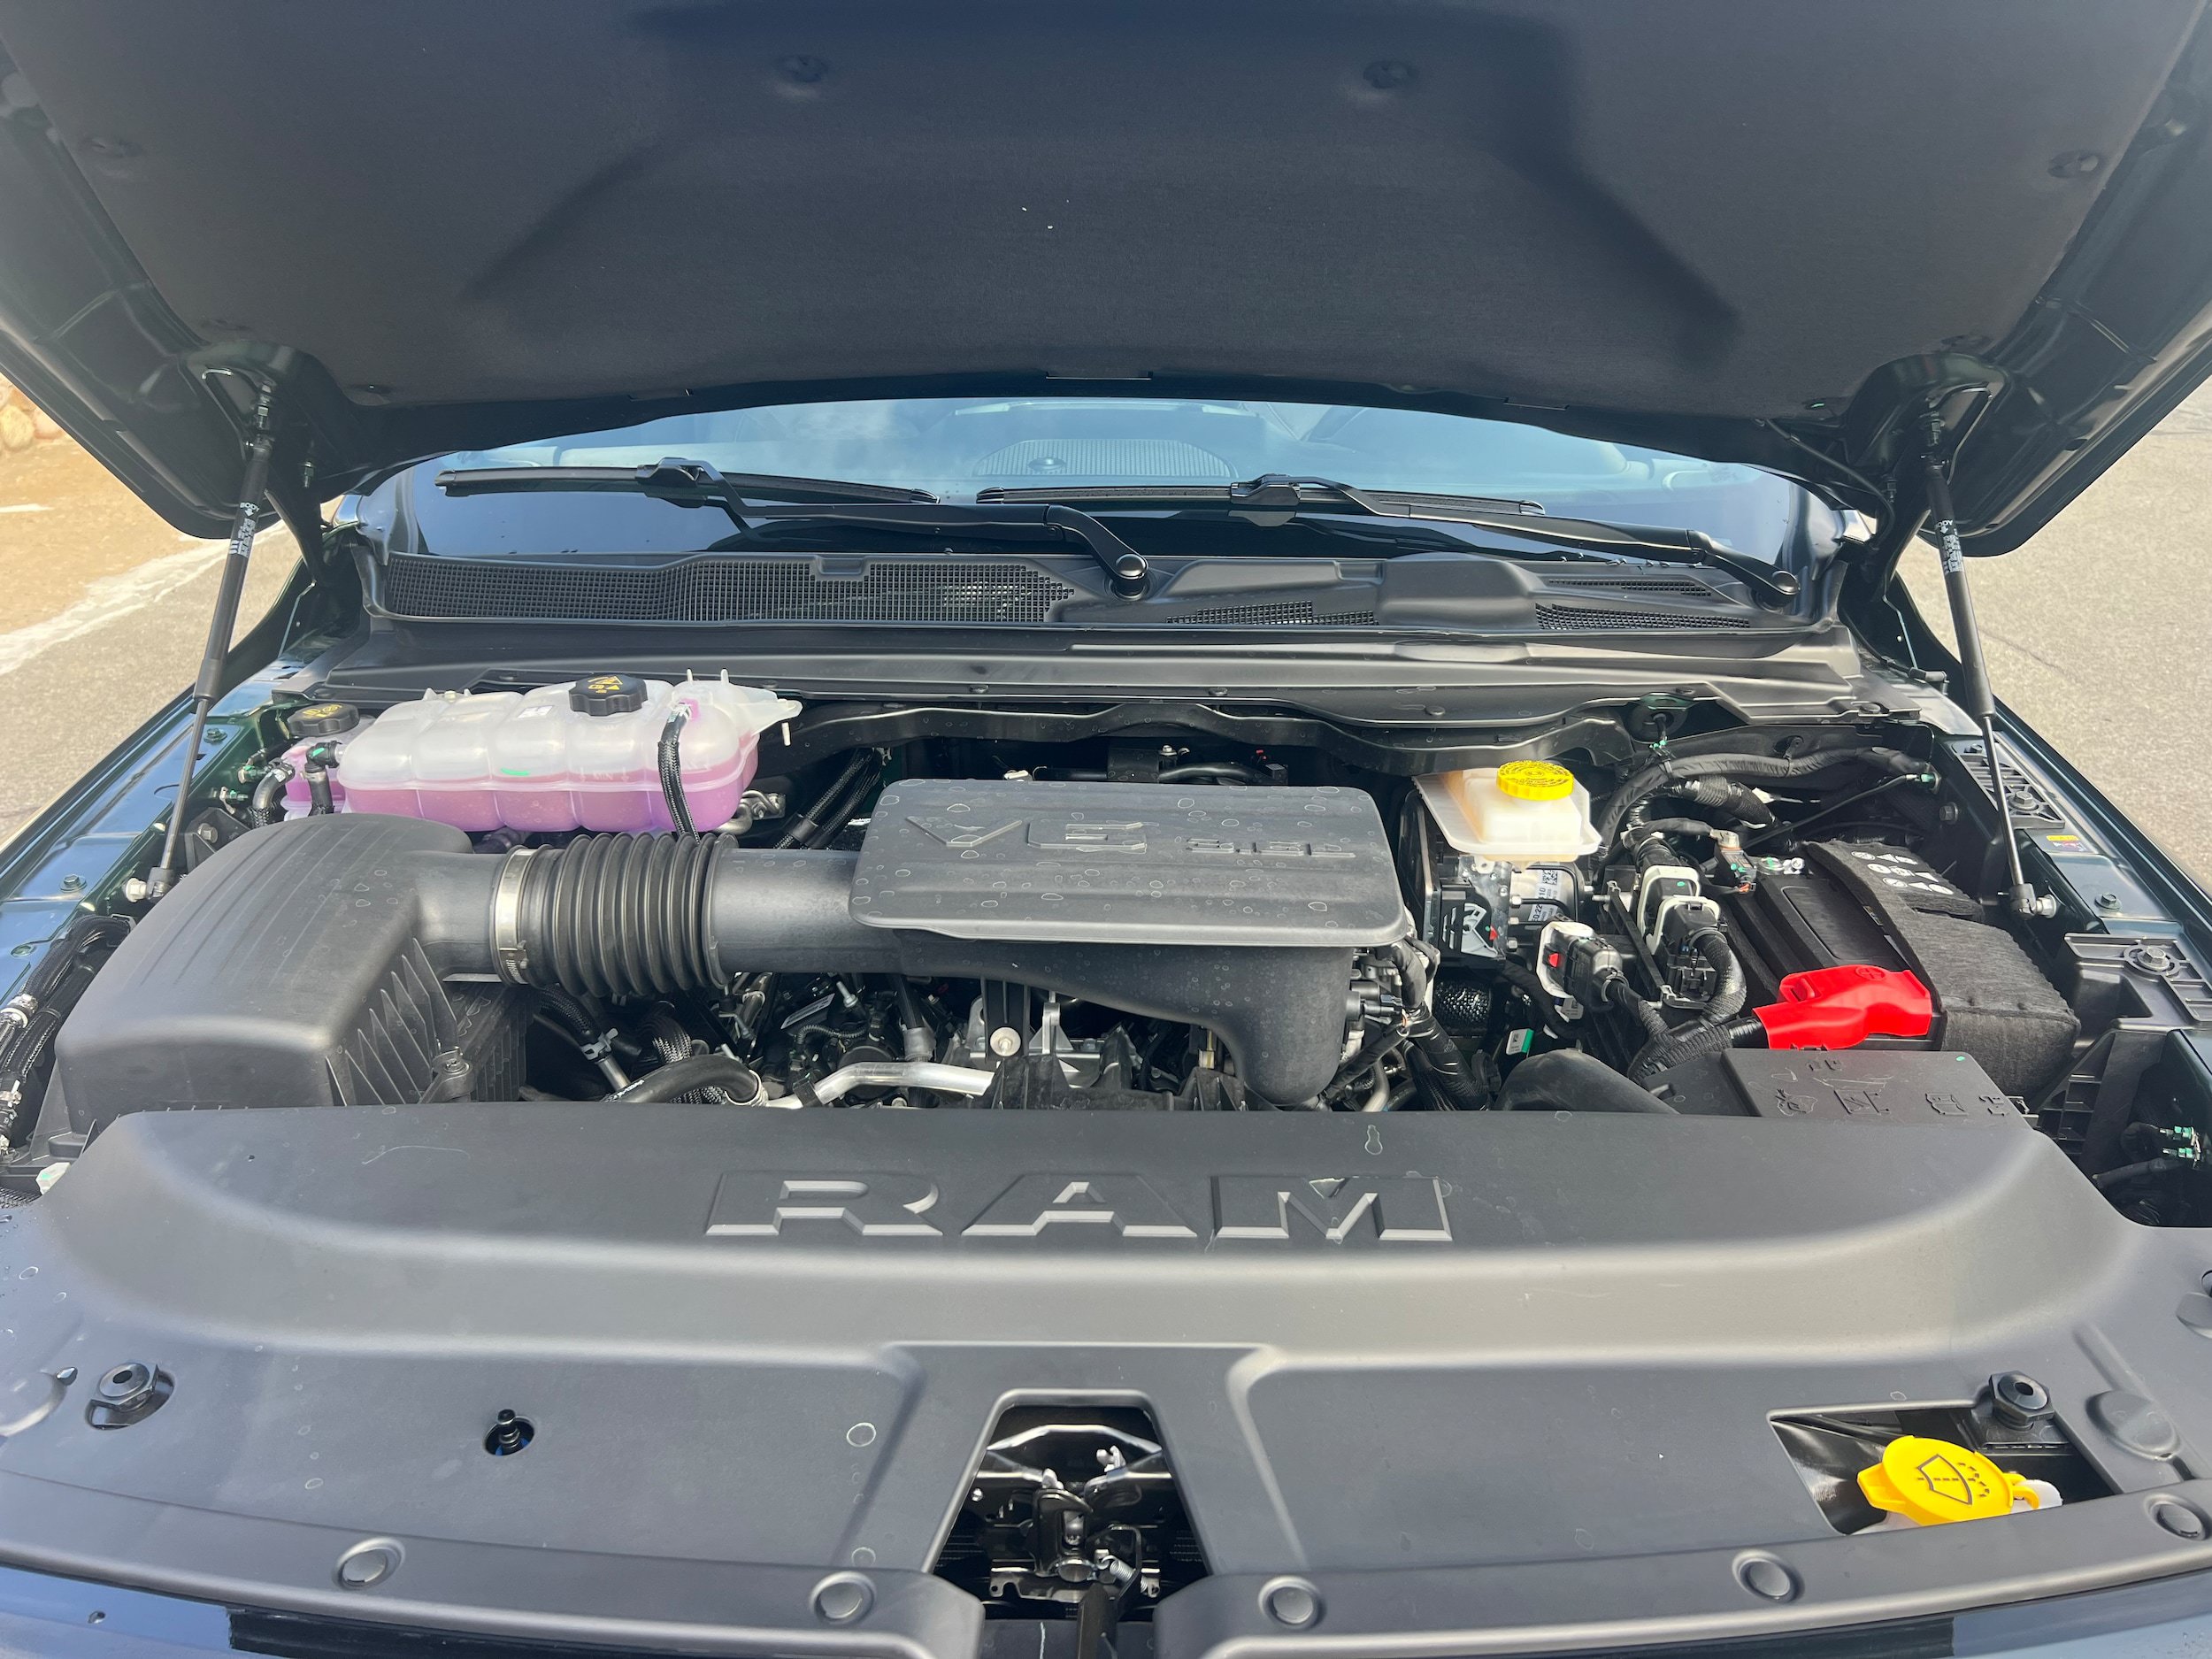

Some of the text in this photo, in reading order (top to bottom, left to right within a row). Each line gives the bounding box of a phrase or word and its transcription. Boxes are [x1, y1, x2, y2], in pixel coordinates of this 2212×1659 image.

[240, 502, 259, 512] BODY
[904, 816, 1149, 850] V6
[705, 1170, 1453, 1240] RAM
